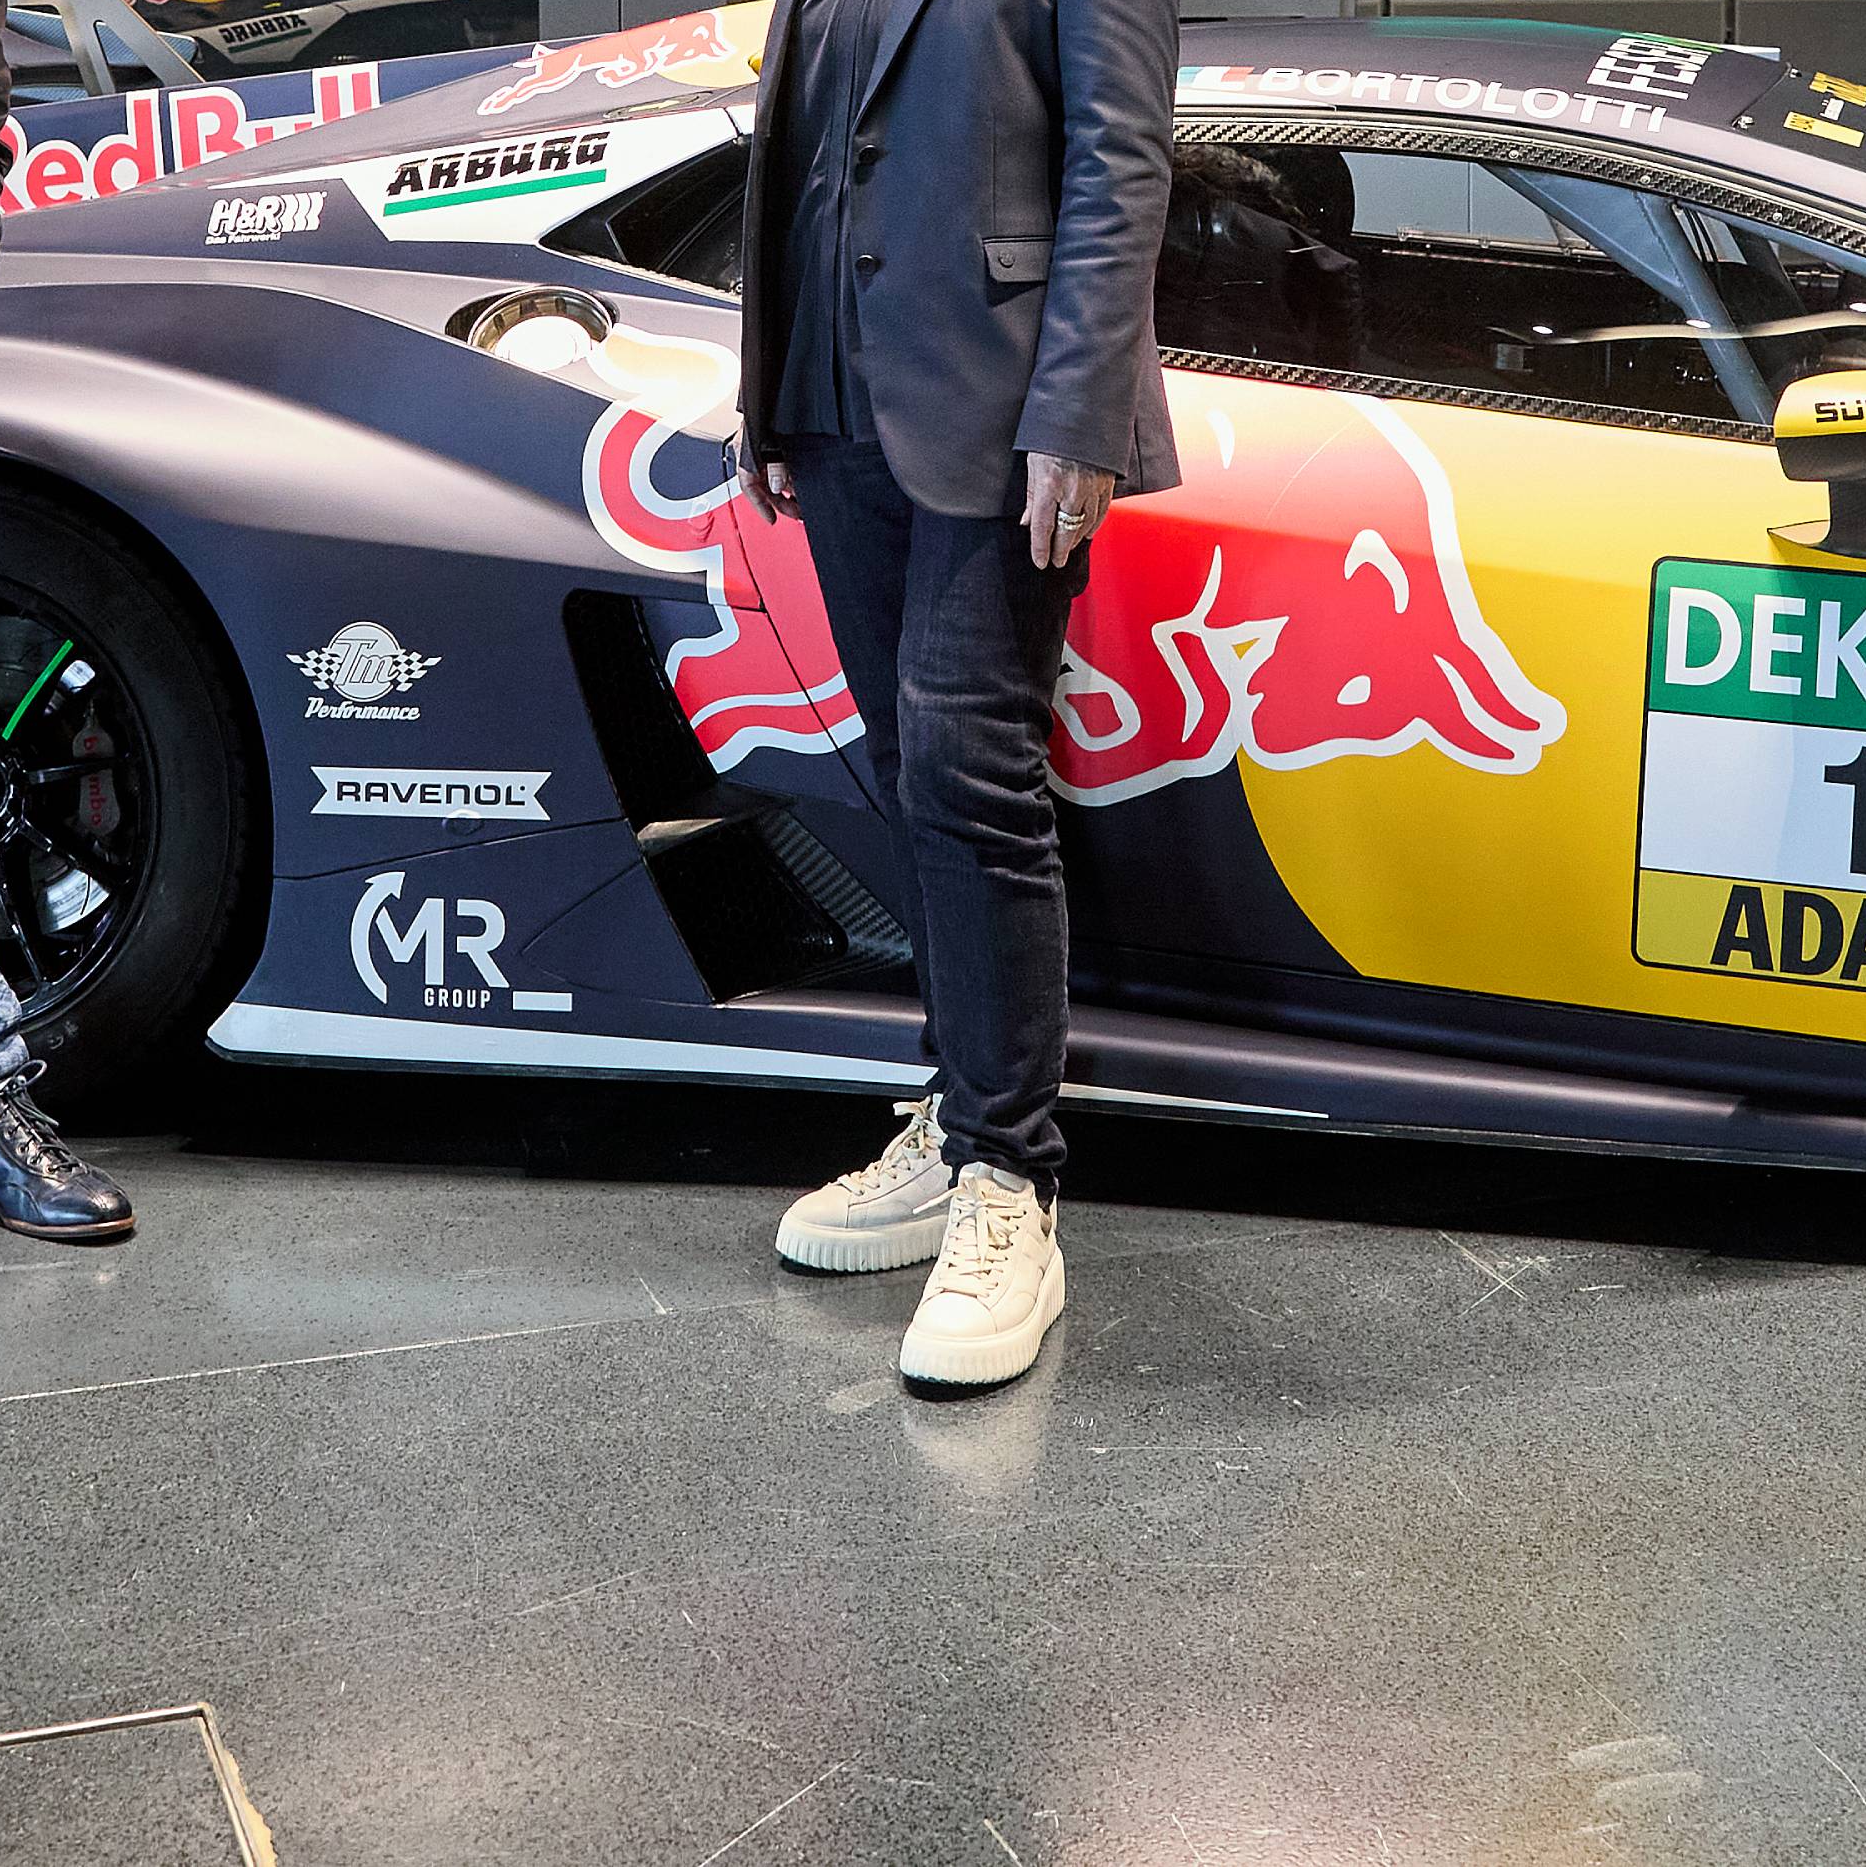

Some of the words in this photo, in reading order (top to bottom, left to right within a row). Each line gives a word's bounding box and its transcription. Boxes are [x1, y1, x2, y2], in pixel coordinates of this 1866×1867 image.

[1257, 67, 1668, 134] BORTOLOTTI
[385, 131, 611, 197] ARBURG
[304, 696, 421, 720] Performance
[336, 781, 526, 807] RAVENOL
[375, 897, 511, 989] MR
[424, 987, 492, 1009] GROUP
